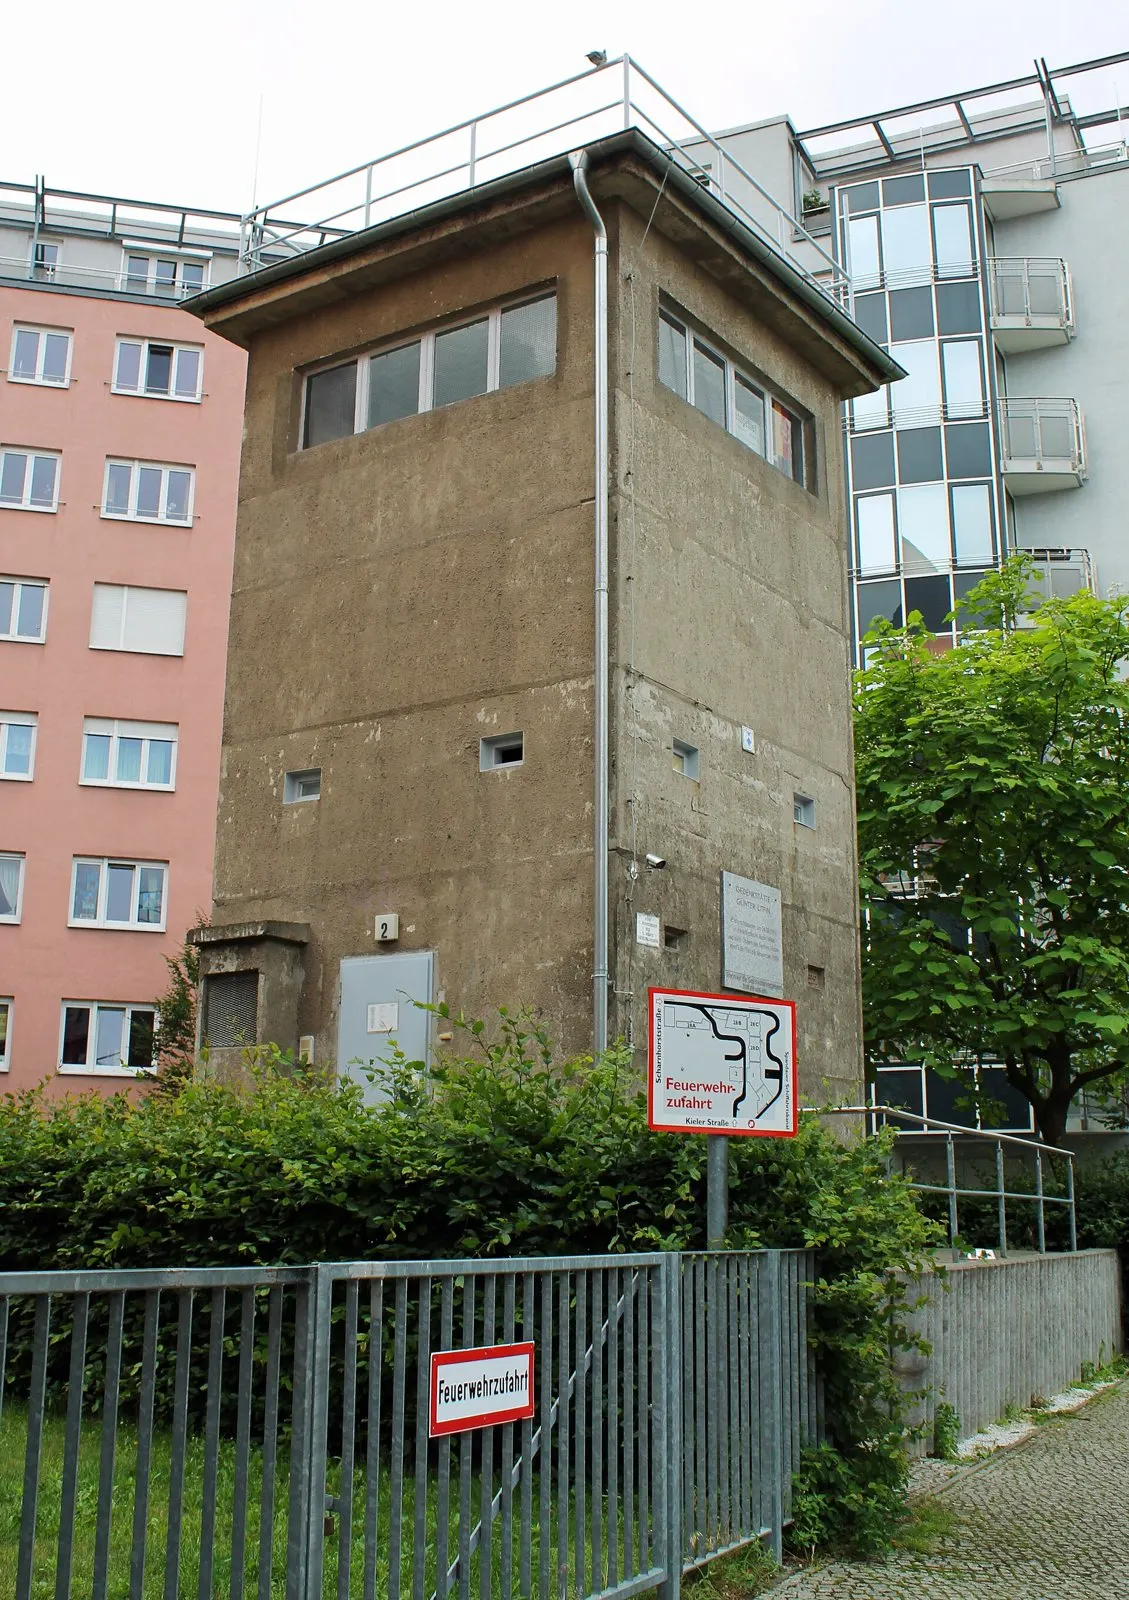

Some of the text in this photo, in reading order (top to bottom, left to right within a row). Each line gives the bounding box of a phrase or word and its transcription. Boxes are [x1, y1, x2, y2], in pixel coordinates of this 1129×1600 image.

[380, 922, 388, 939] 2
[666, 1077, 736, 1094] Feuerwehr-
[666, 1096, 712, 1110] zufahrt
[685, 1117, 730, 1127] Kieler Straße
[438, 1369, 528, 1405] Feuerwehrzufahrt
